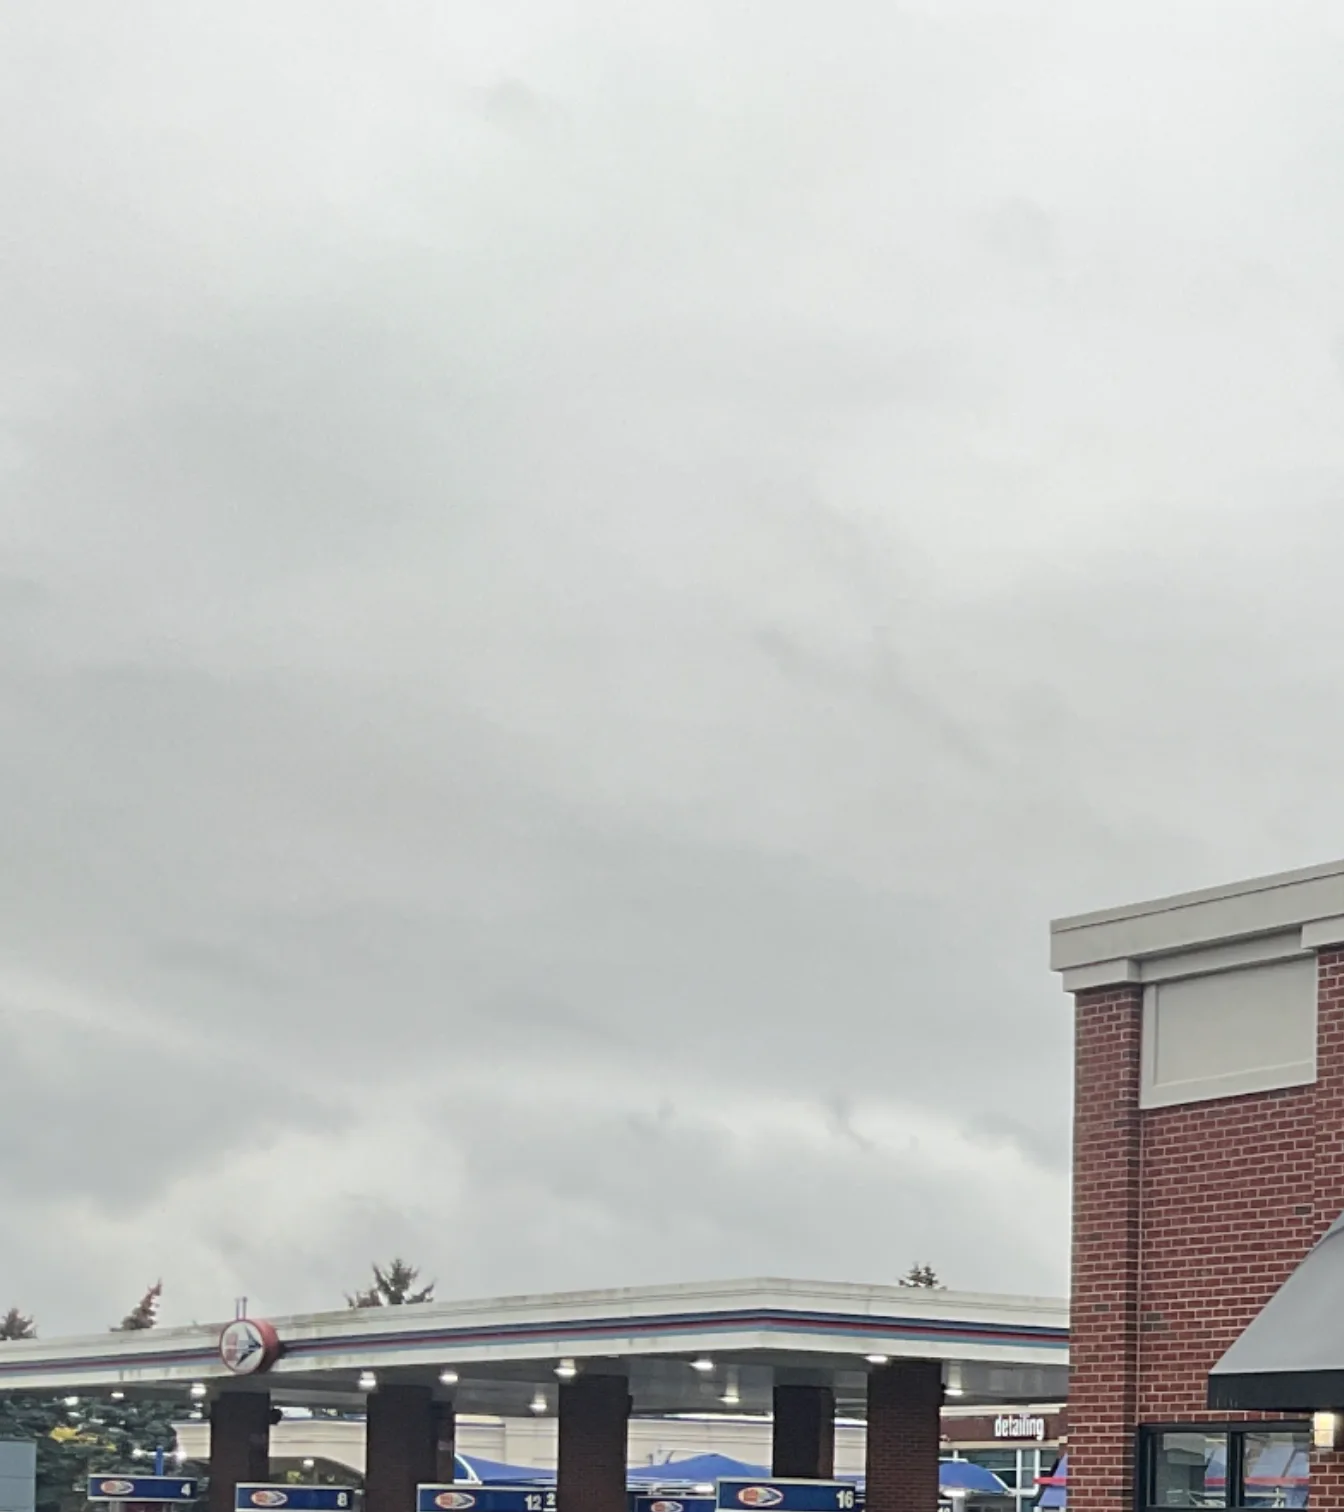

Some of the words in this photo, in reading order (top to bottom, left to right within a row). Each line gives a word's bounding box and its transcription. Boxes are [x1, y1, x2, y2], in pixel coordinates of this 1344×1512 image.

[994, 1412, 1044, 1441] detailing
[337, 1492, 348, 1507] 8
[524, 1494, 542, 1511] 12
[836, 1490, 854, 1509] 16
